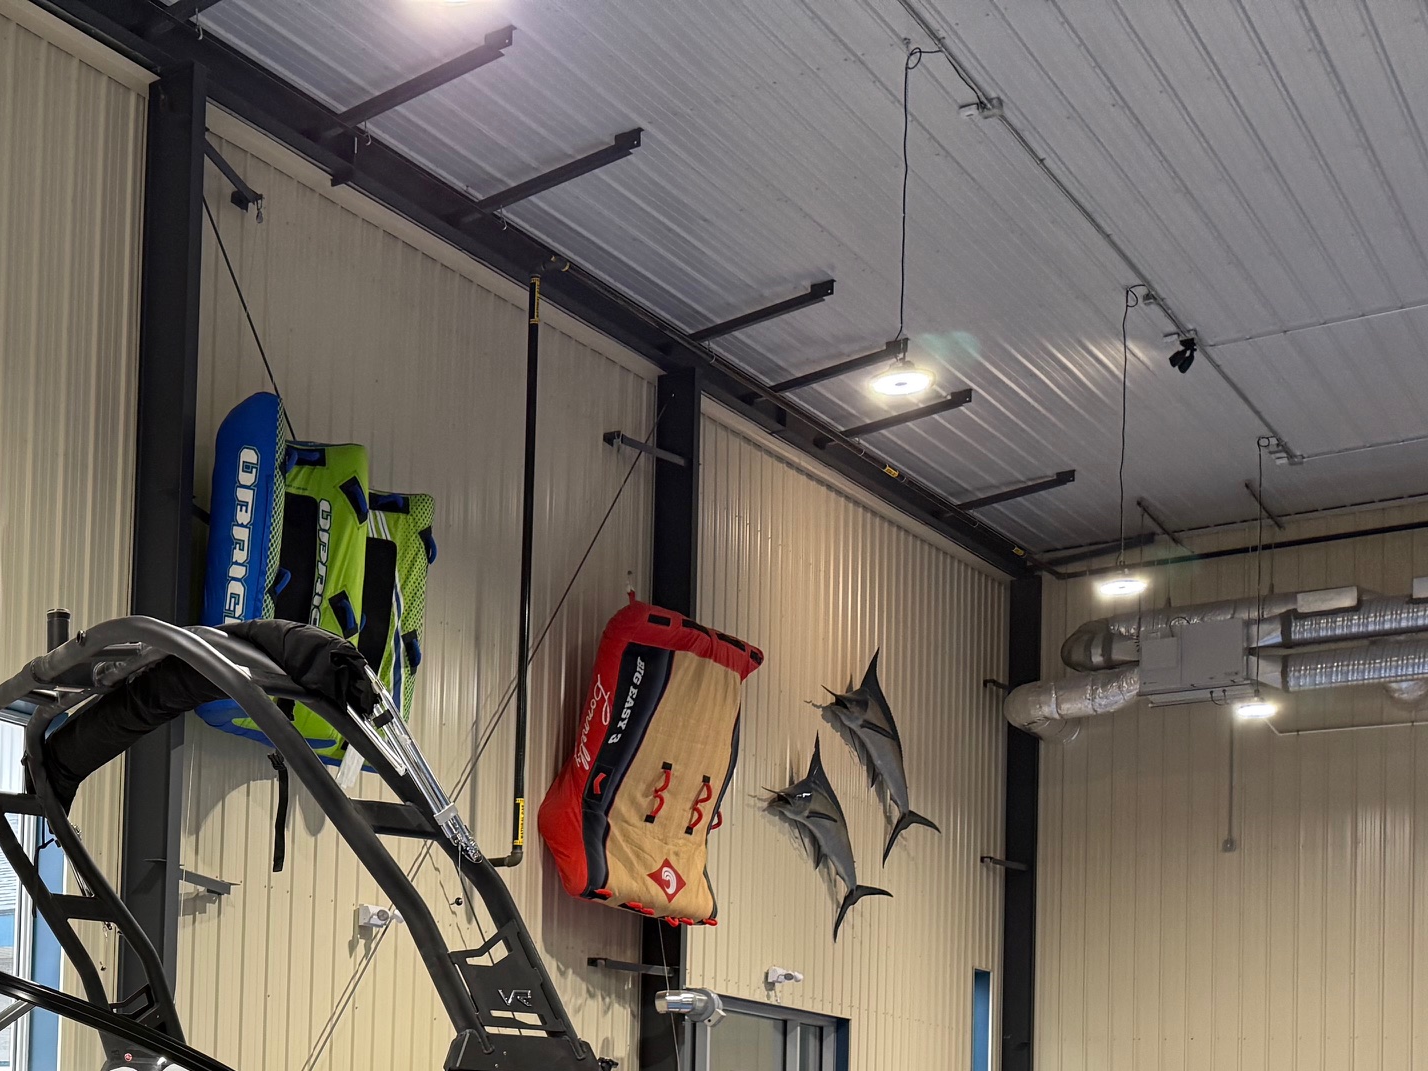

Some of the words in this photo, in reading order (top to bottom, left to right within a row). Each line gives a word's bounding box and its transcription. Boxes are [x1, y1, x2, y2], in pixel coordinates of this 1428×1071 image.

[224, 446, 260, 627] OBRIE
[633, 656, 646, 685] BIG
[617, 686, 639, 730] EASY
[608, 733, 622, 744] 3
[498, 989, 532, 1007] VR
